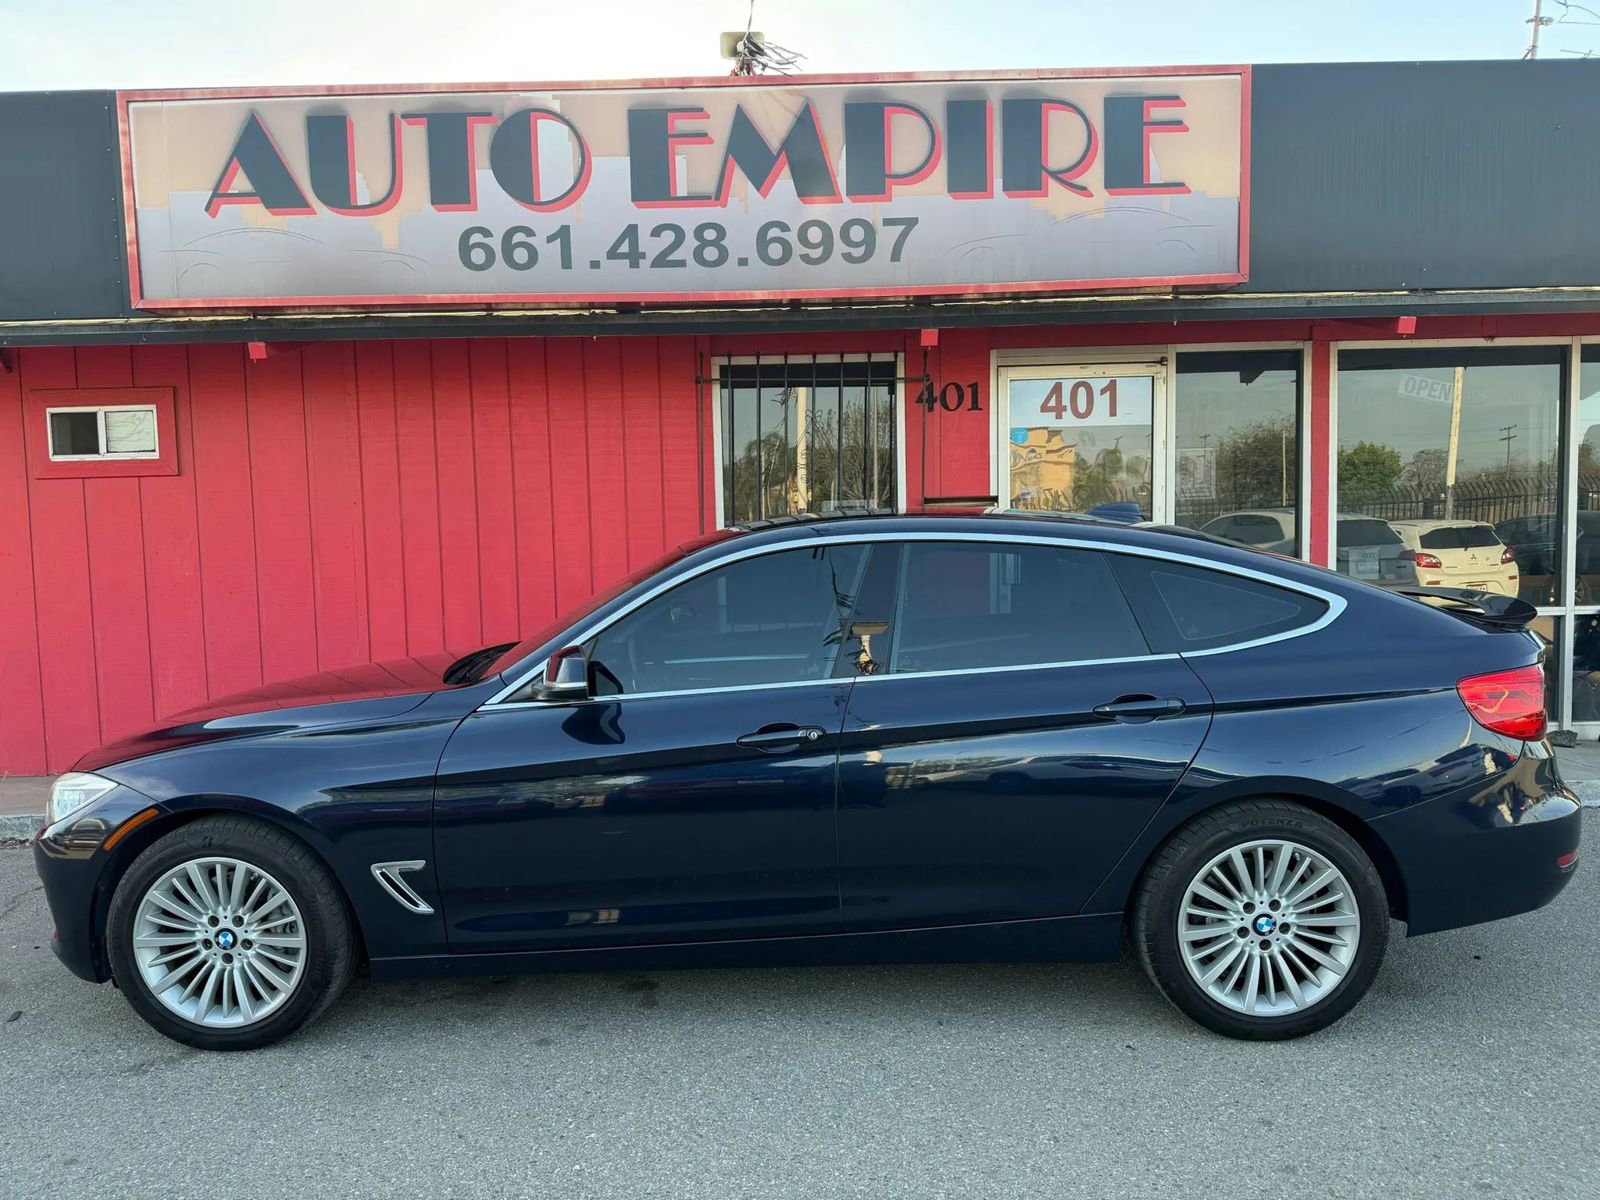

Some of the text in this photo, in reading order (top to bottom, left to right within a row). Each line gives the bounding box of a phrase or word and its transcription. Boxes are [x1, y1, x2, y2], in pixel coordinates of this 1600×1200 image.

[204, 94, 1192, 218] AUTO EMPIRE
[458, 216, 919, 271] 661.428.6997
[915, 380, 983, 412] 401
[1040, 379, 1117, 420] 401
[1404, 376, 1452, 401] OPEN
